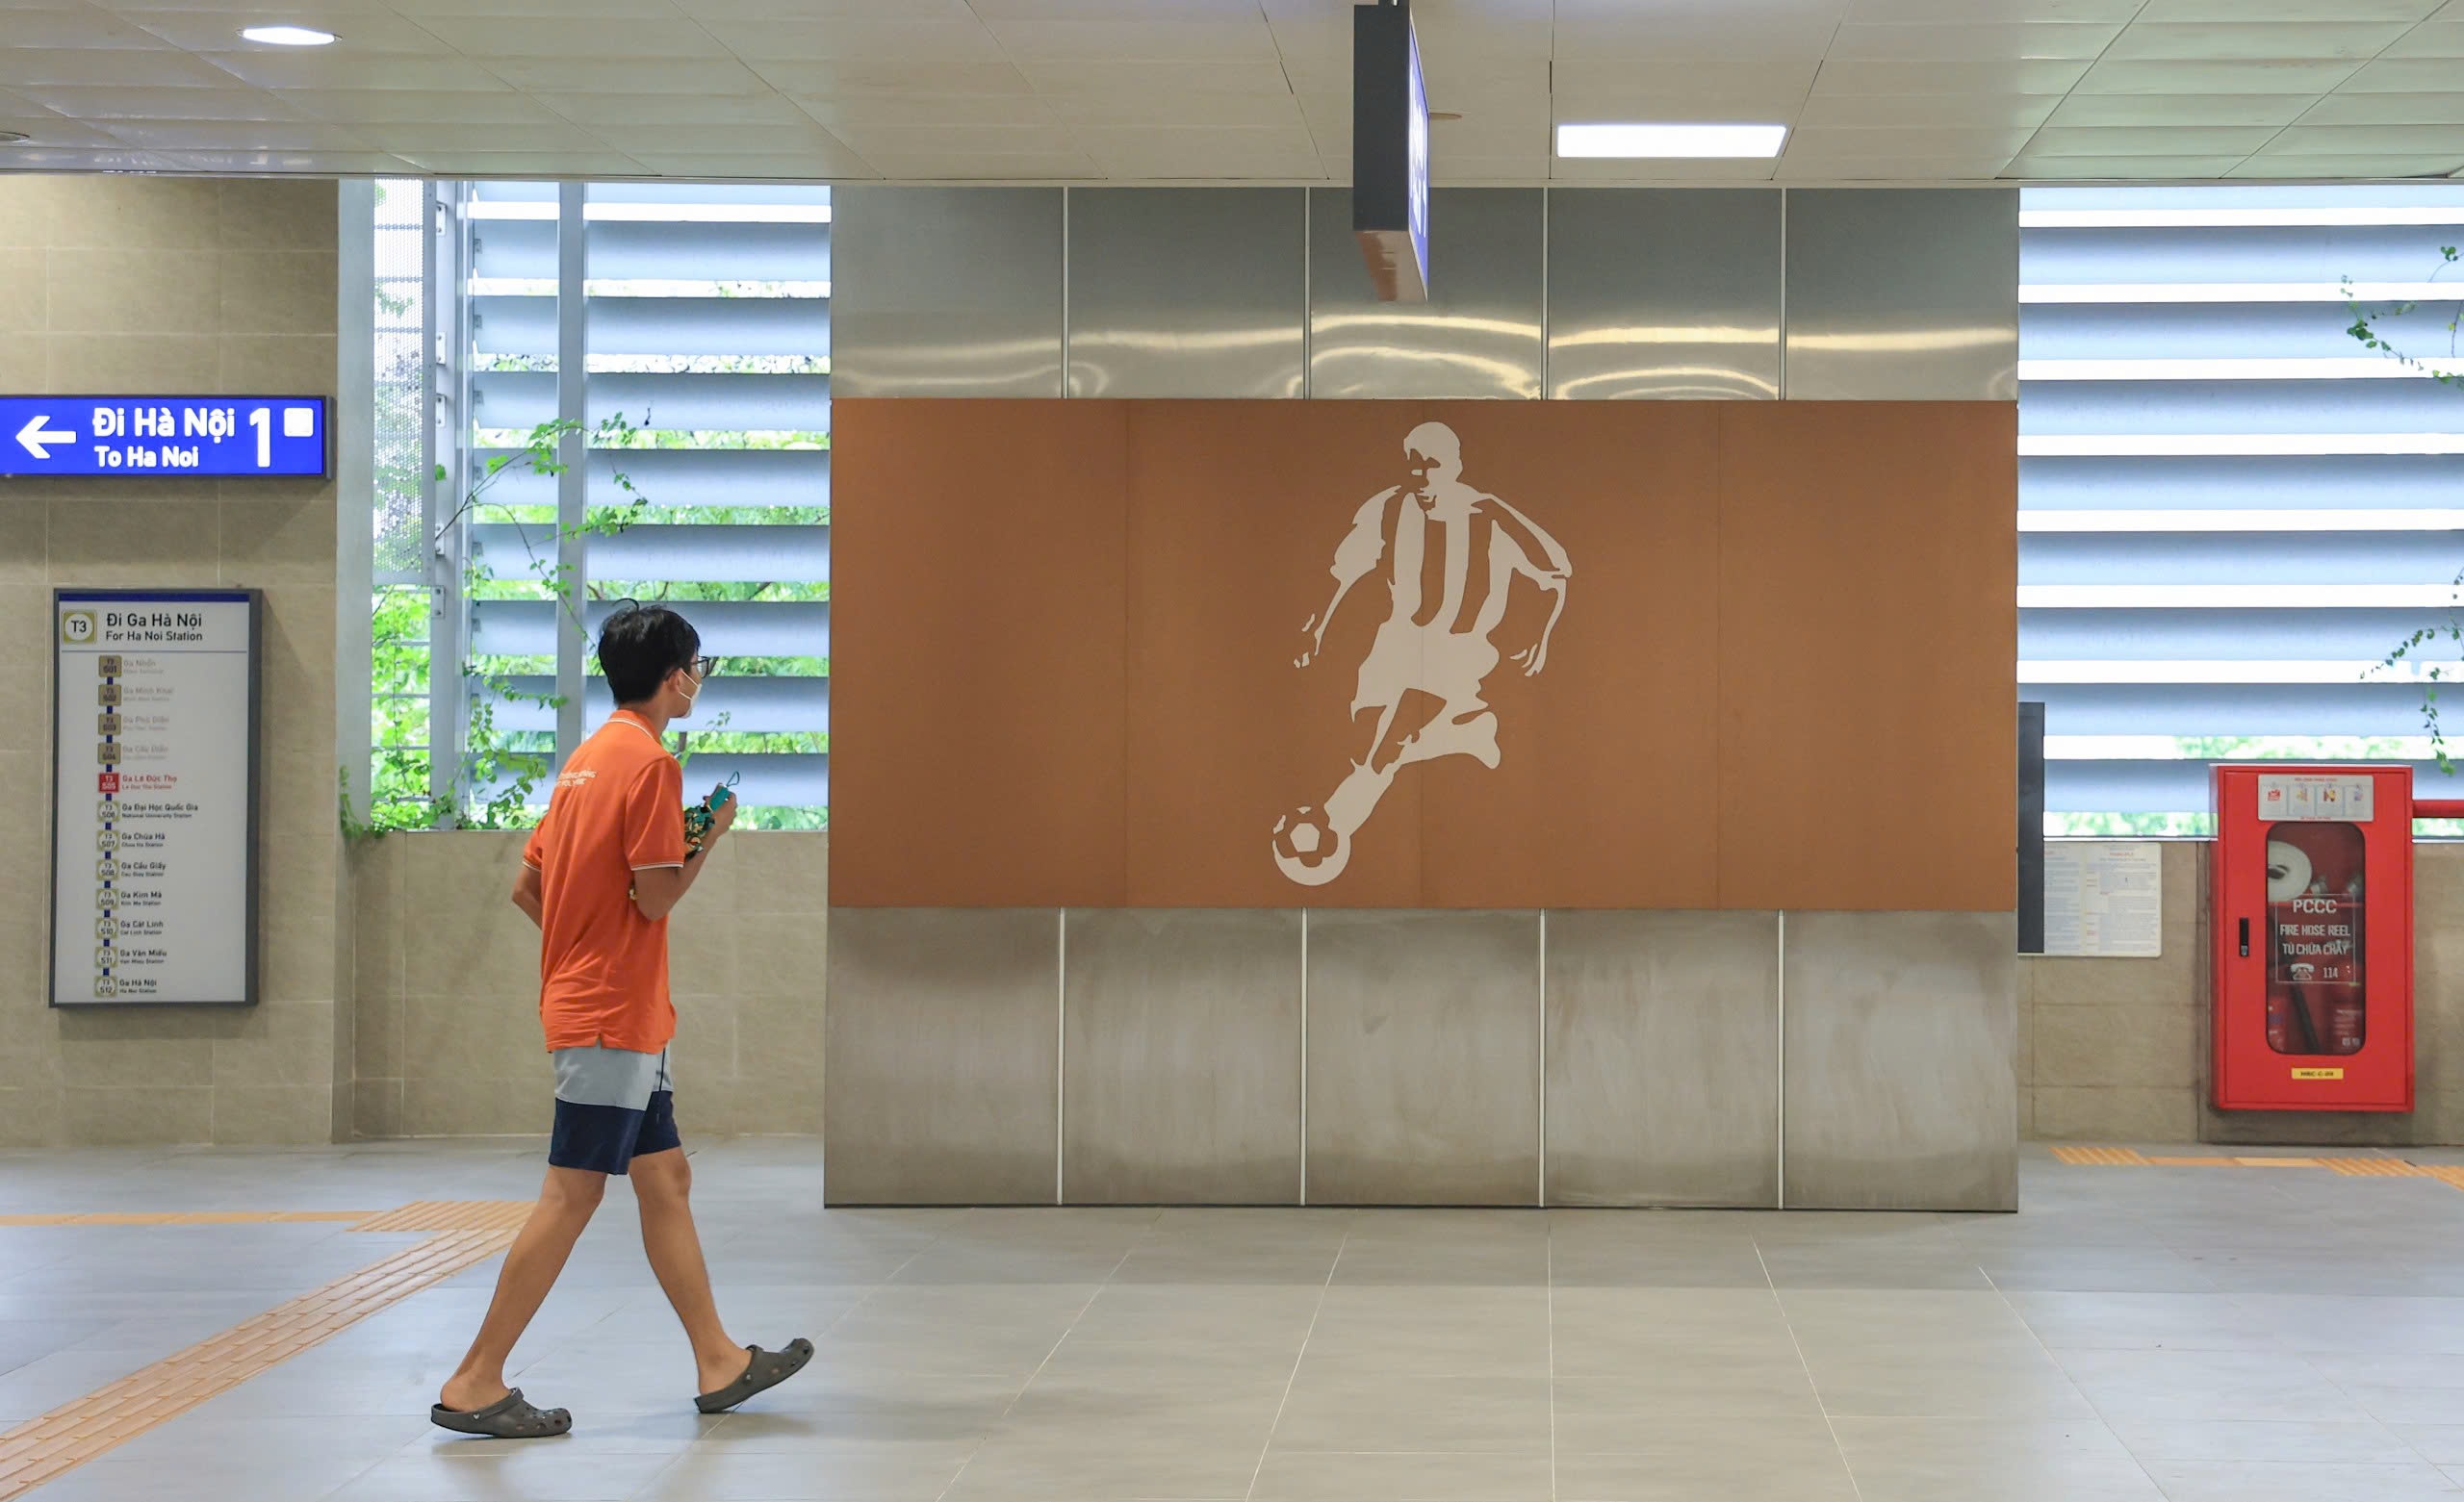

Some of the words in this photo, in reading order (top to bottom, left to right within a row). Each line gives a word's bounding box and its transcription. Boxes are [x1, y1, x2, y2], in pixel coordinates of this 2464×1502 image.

[93, 408, 125, 437] Đi
[135, 407, 175, 437] Hà
[185, 407, 235, 444] Nội
[249, 408, 270, 468] 1
[94, 446, 121, 468] To
[127, 446, 157, 468] Ha
[162, 446, 198, 468] Noi
[71, 621, 87, 633] T3
[107, 613, 122, 626] Đi
[127, 613, 146, 626] Ga
[151, 613, 171, 626] Hà
[177, 613, 202, 630] Nội
[106, 631, 123, 641] For
[127, 631, 141, 641] Ha
[144, 631, 163, 641] Noi
[166, 631, 202, 641] Station
[2293, 899, 2337, 914] PCCC
[2279, 924, 2299, 936] FIRE
[2301, 924, 2326, 936] HOSE
[2328, 924, 2350, 936] REEL
[2323, 967, 2339, 979] 114
